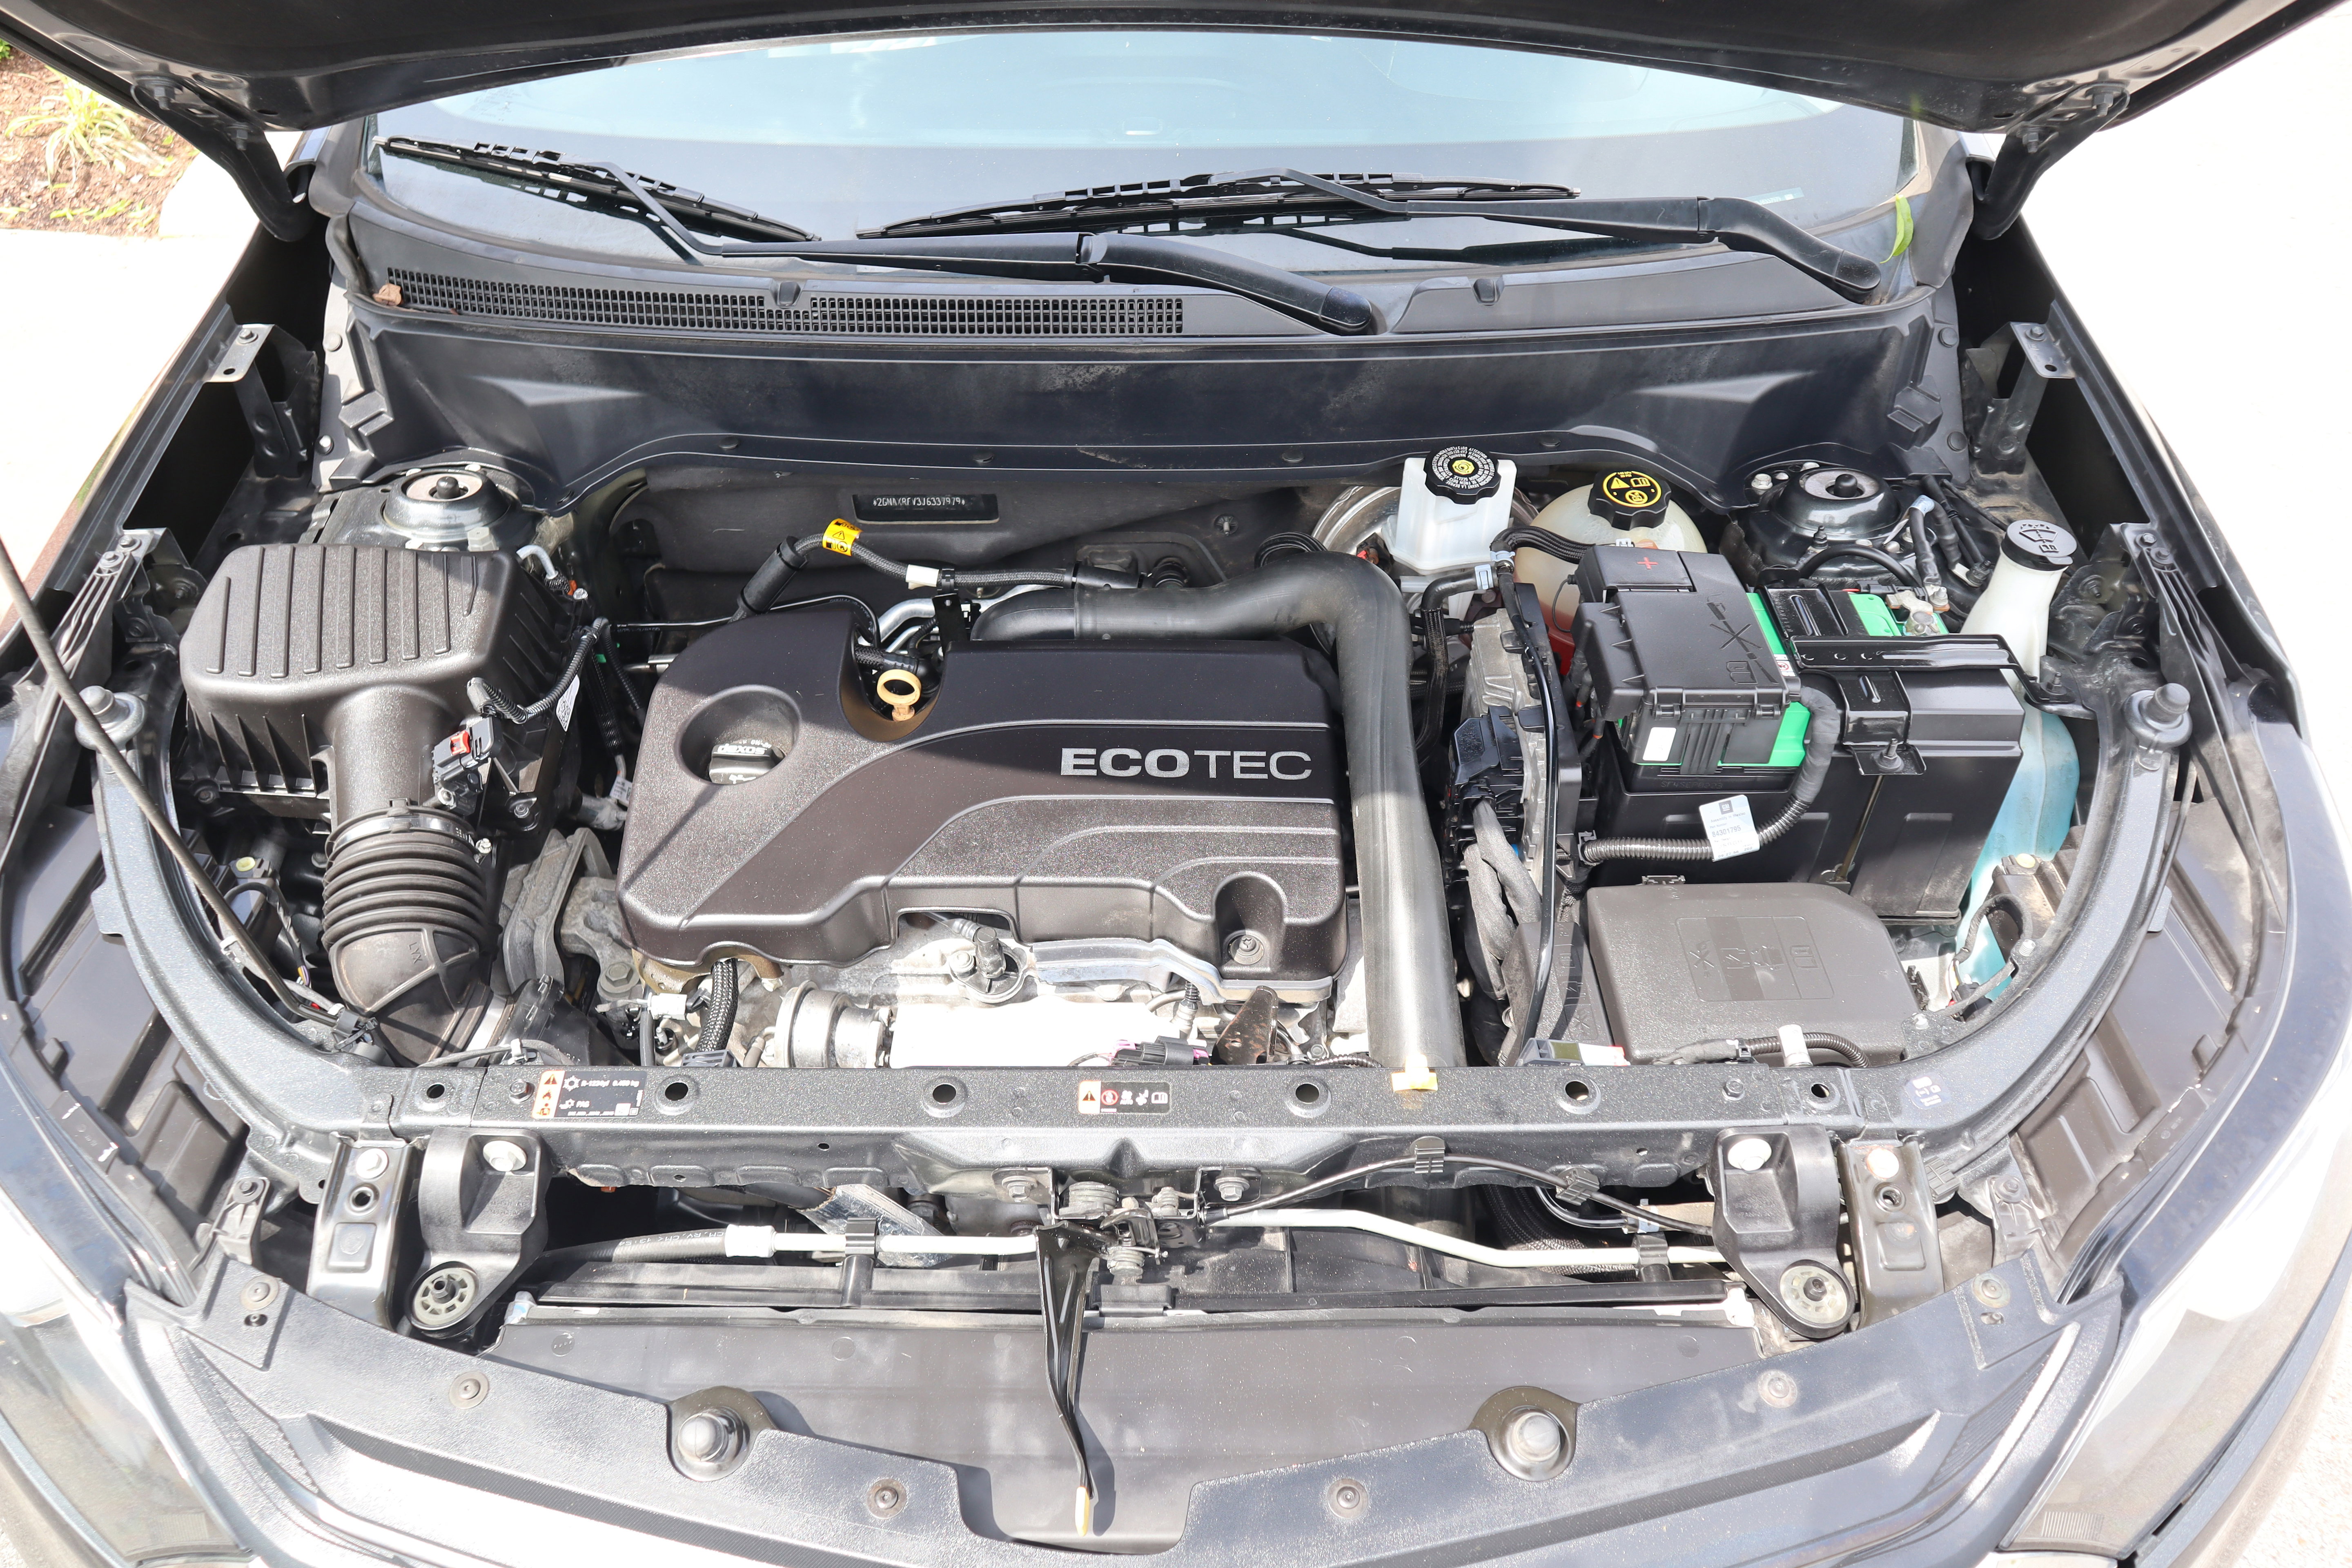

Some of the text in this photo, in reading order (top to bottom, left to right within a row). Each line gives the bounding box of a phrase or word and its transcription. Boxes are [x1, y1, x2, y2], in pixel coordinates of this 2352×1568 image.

[717, 743, 766, 755] dexos
[1060, 748, 1312, 780] ECOTEC
[1712, 825, 1741, 837] 84301795
[409, 942, 423, 964] LYX
